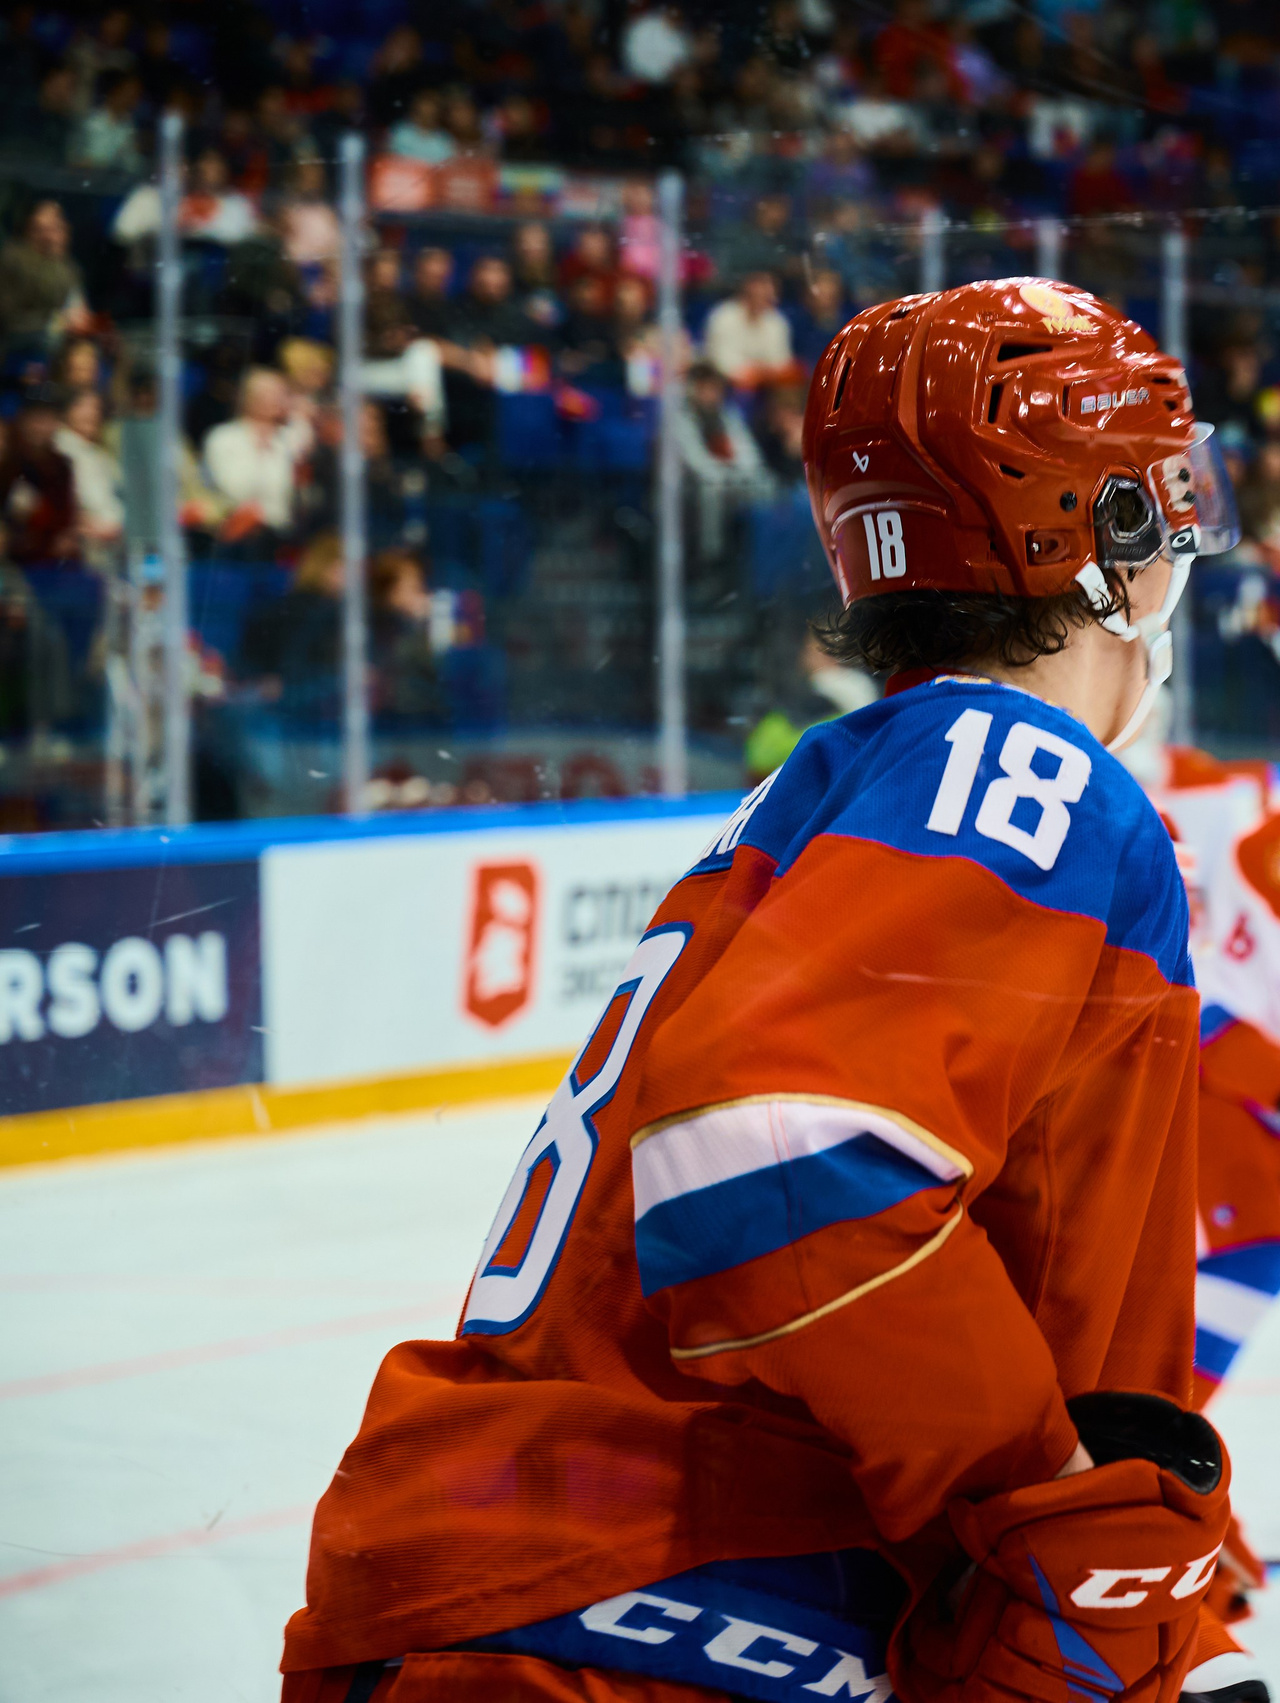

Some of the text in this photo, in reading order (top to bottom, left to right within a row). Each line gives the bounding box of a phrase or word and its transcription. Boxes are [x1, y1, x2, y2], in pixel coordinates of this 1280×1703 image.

[1080, 387, 1150, 414] BAUER
[862, 511, 906, 580] 18
[926, 708, 1092, 871] 18
[0, 929, 228, 1044] RSON
[578, 1591, 894, 1703] CCM
